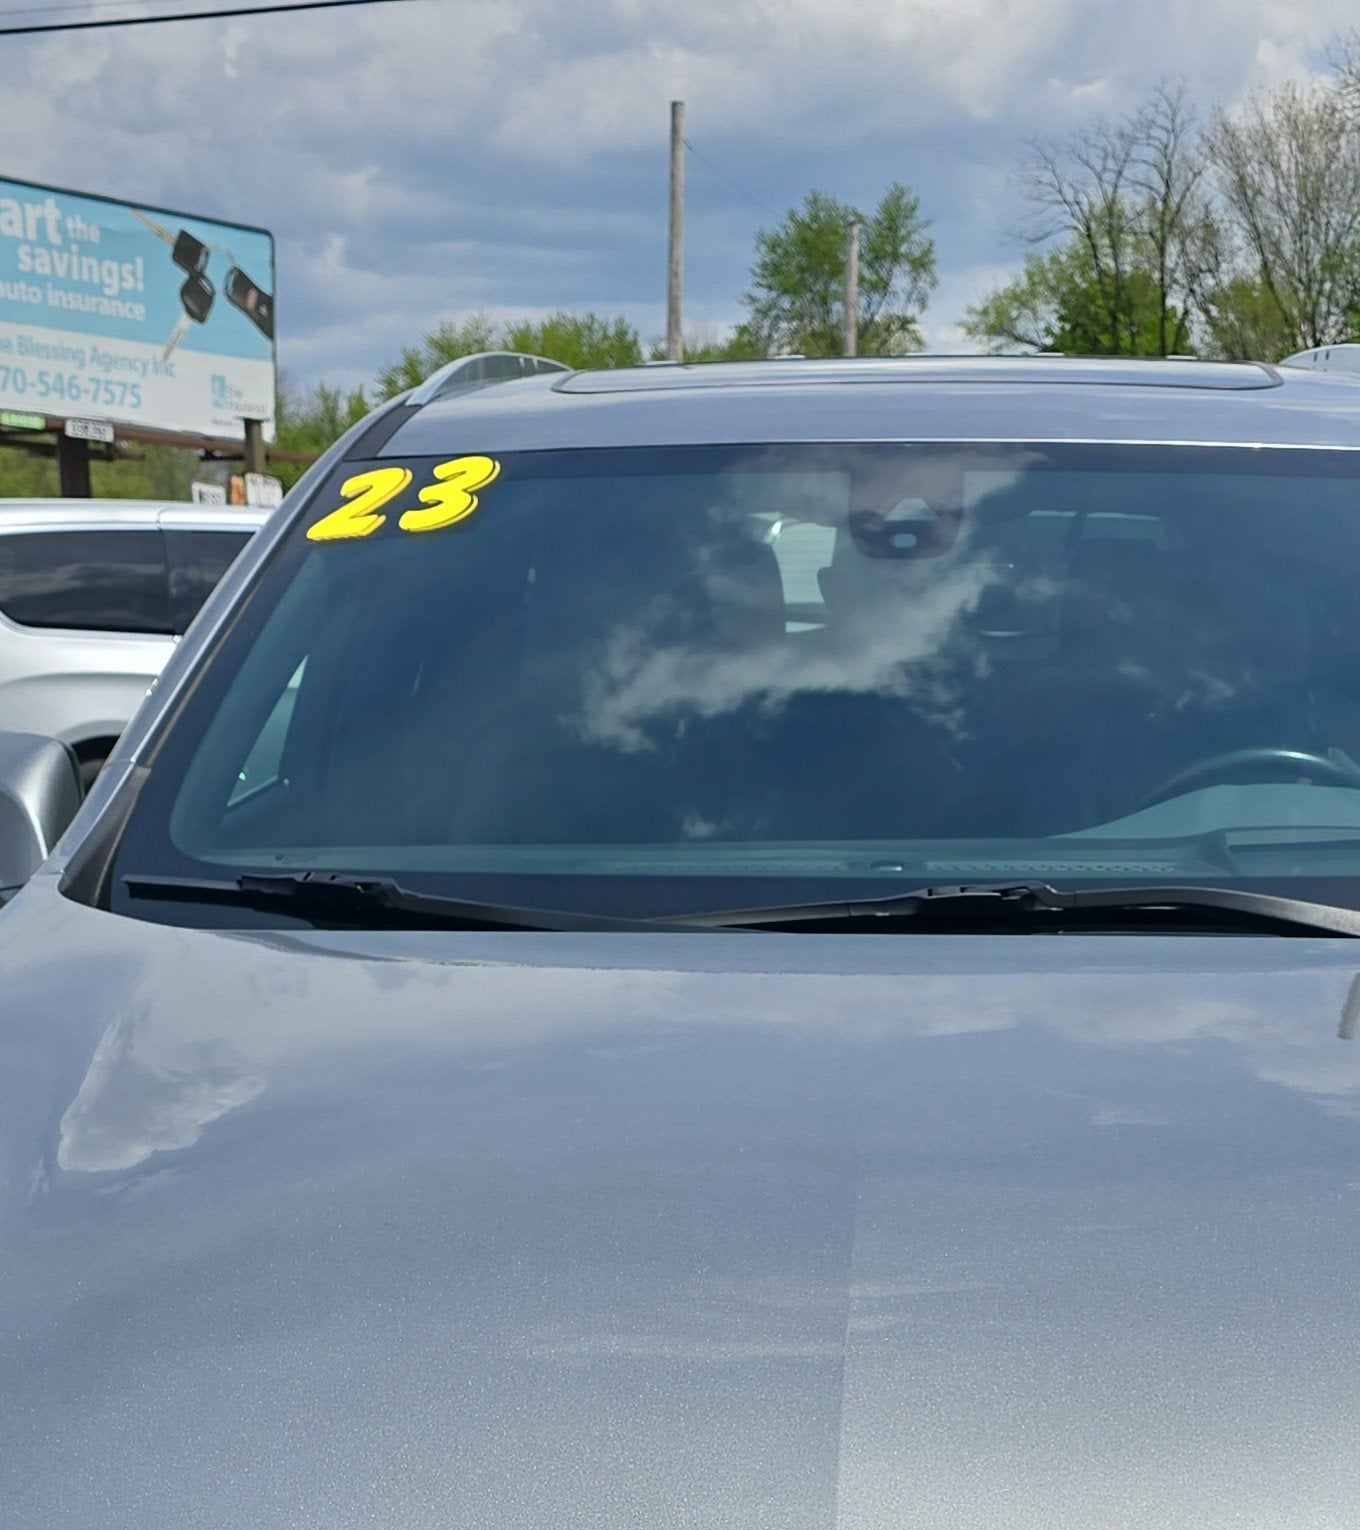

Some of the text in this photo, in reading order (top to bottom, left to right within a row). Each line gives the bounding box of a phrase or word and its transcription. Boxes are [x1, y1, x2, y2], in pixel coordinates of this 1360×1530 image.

[66, 214, 101, 244] the
[18, 243, 144, 296] savings!
[47, 283, 146, 322] insurance
[91, 345, 148, 377] Agency
[306, 456, 501, 541] 23
